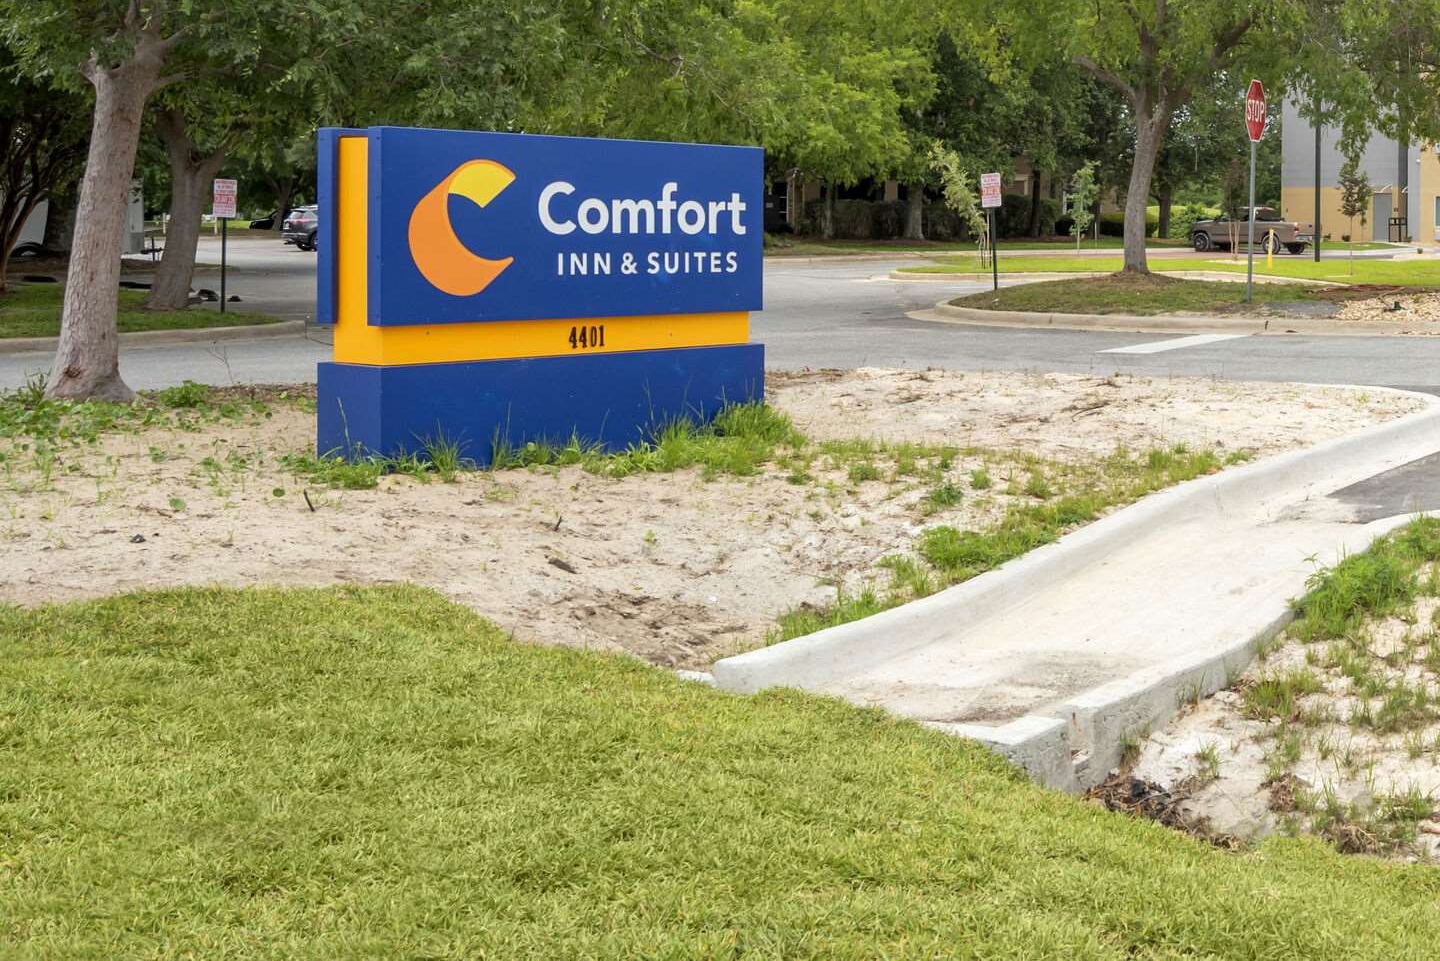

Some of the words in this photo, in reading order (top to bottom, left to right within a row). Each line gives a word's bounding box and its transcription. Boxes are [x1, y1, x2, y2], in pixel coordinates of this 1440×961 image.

[1247, 99, 1265, 123] STOP
[537, 181, 747, 236] Comfort
[557, 252, 612, 276] INN
[620, 252, 638, 275] &
[647, 251, 738, 274] SUITES
[568, 325, 605, 349] 4401
